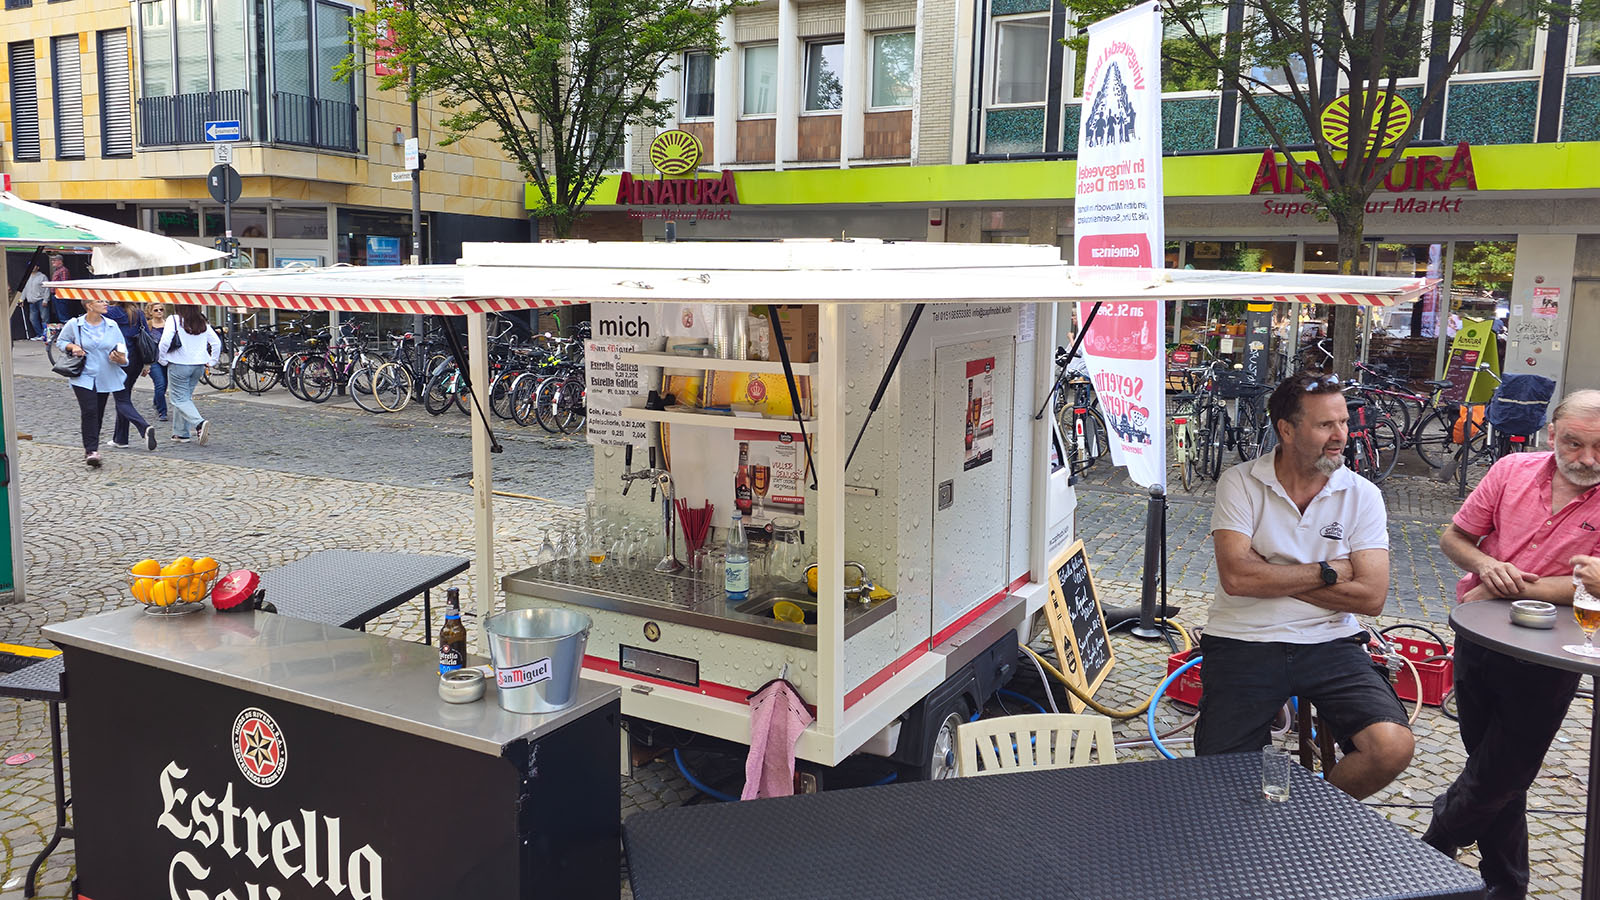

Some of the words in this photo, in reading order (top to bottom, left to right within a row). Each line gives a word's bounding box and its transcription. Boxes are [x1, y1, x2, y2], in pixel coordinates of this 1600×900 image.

[1249, 142, 1477, 195] ALNURA
[616, 169, 738, 204] ALNATURA
[1393, 195, 1463, 214] Markt
[625, 208, 658, 222] Super
[661, 208, 695, 221] Natur
[696, 208, 732, 220] Markt
[600, 315, 649, 337] mich
[244, 711, 253, 720] DE
[261, 774, 279, 784] DESDE
[157, 760, 383, 900] Estrella
